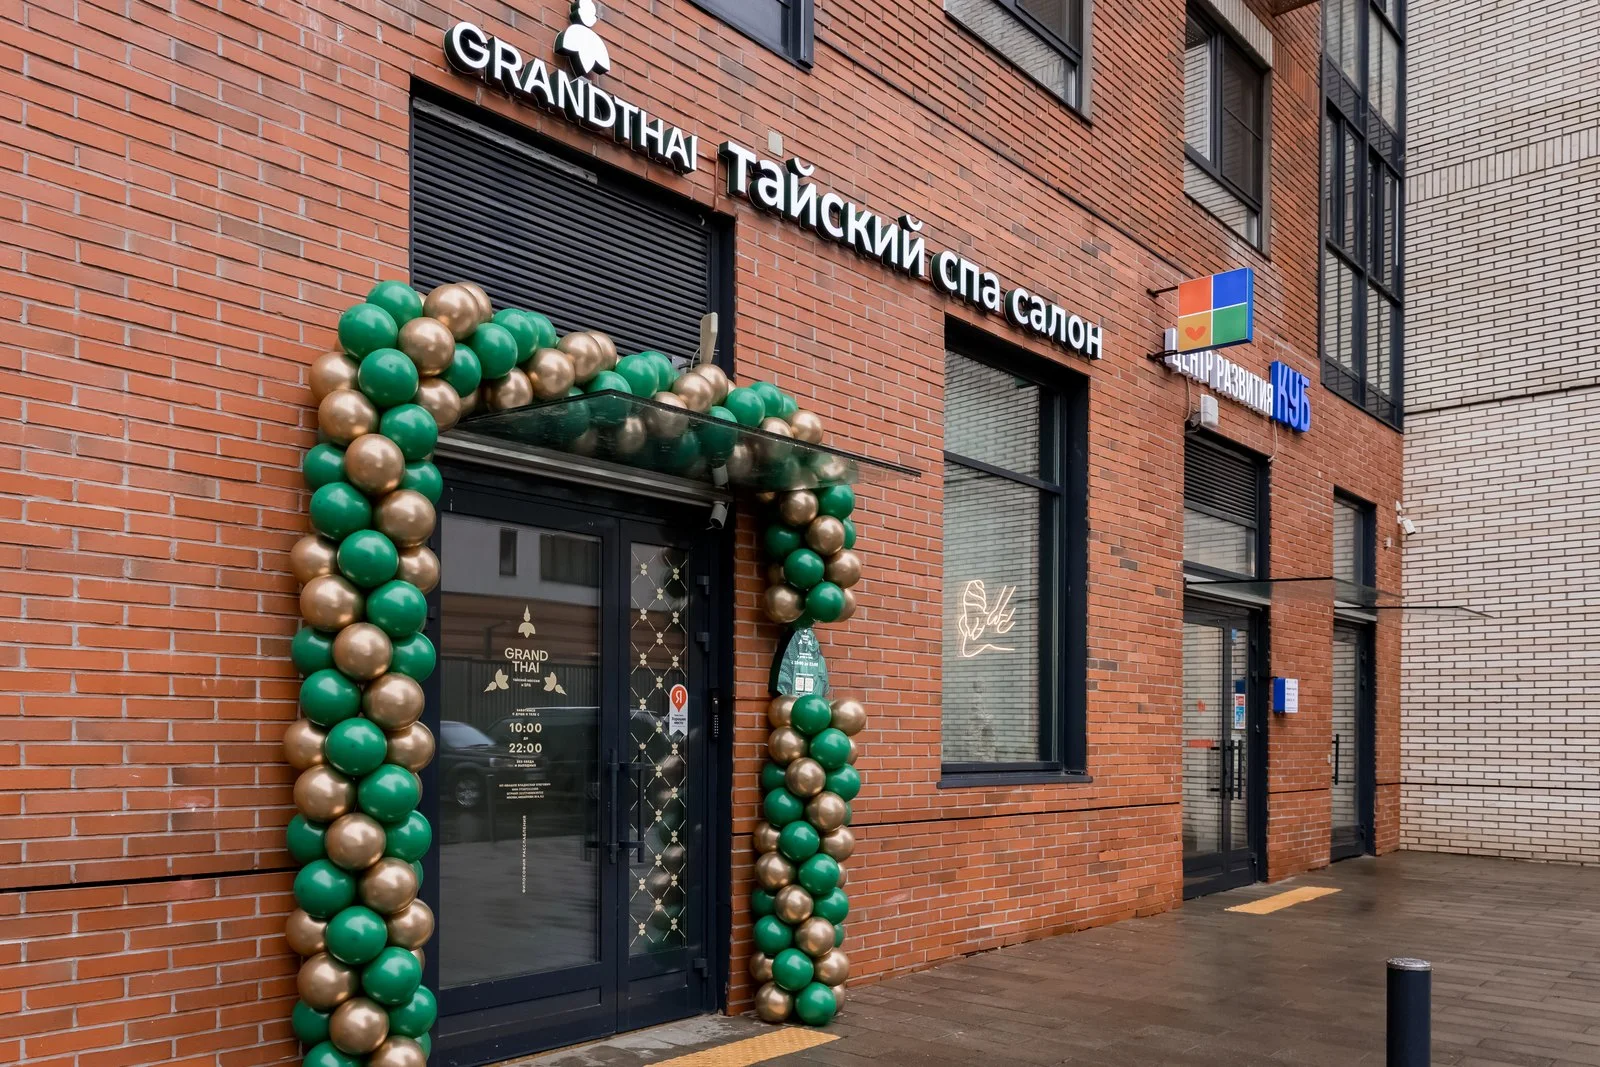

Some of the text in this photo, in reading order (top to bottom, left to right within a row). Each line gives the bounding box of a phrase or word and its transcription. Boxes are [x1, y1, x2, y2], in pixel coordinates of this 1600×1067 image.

[449, 21, 698, 172] GRANDTHAI
[724, 140, 1103, 359] тайский спа салон
[1215, 354, 1274, 417] РАЗВИТИЯ
[1274, 361, 1311, 432] КУБ
[504, 647, 548, 661] GRAND
[511, 661, 540, 673] THAI
[675, 690, 683, 704] Я
[509, 722, 542, 733] 10:00
[508, 743, 542, 753] 22:00
